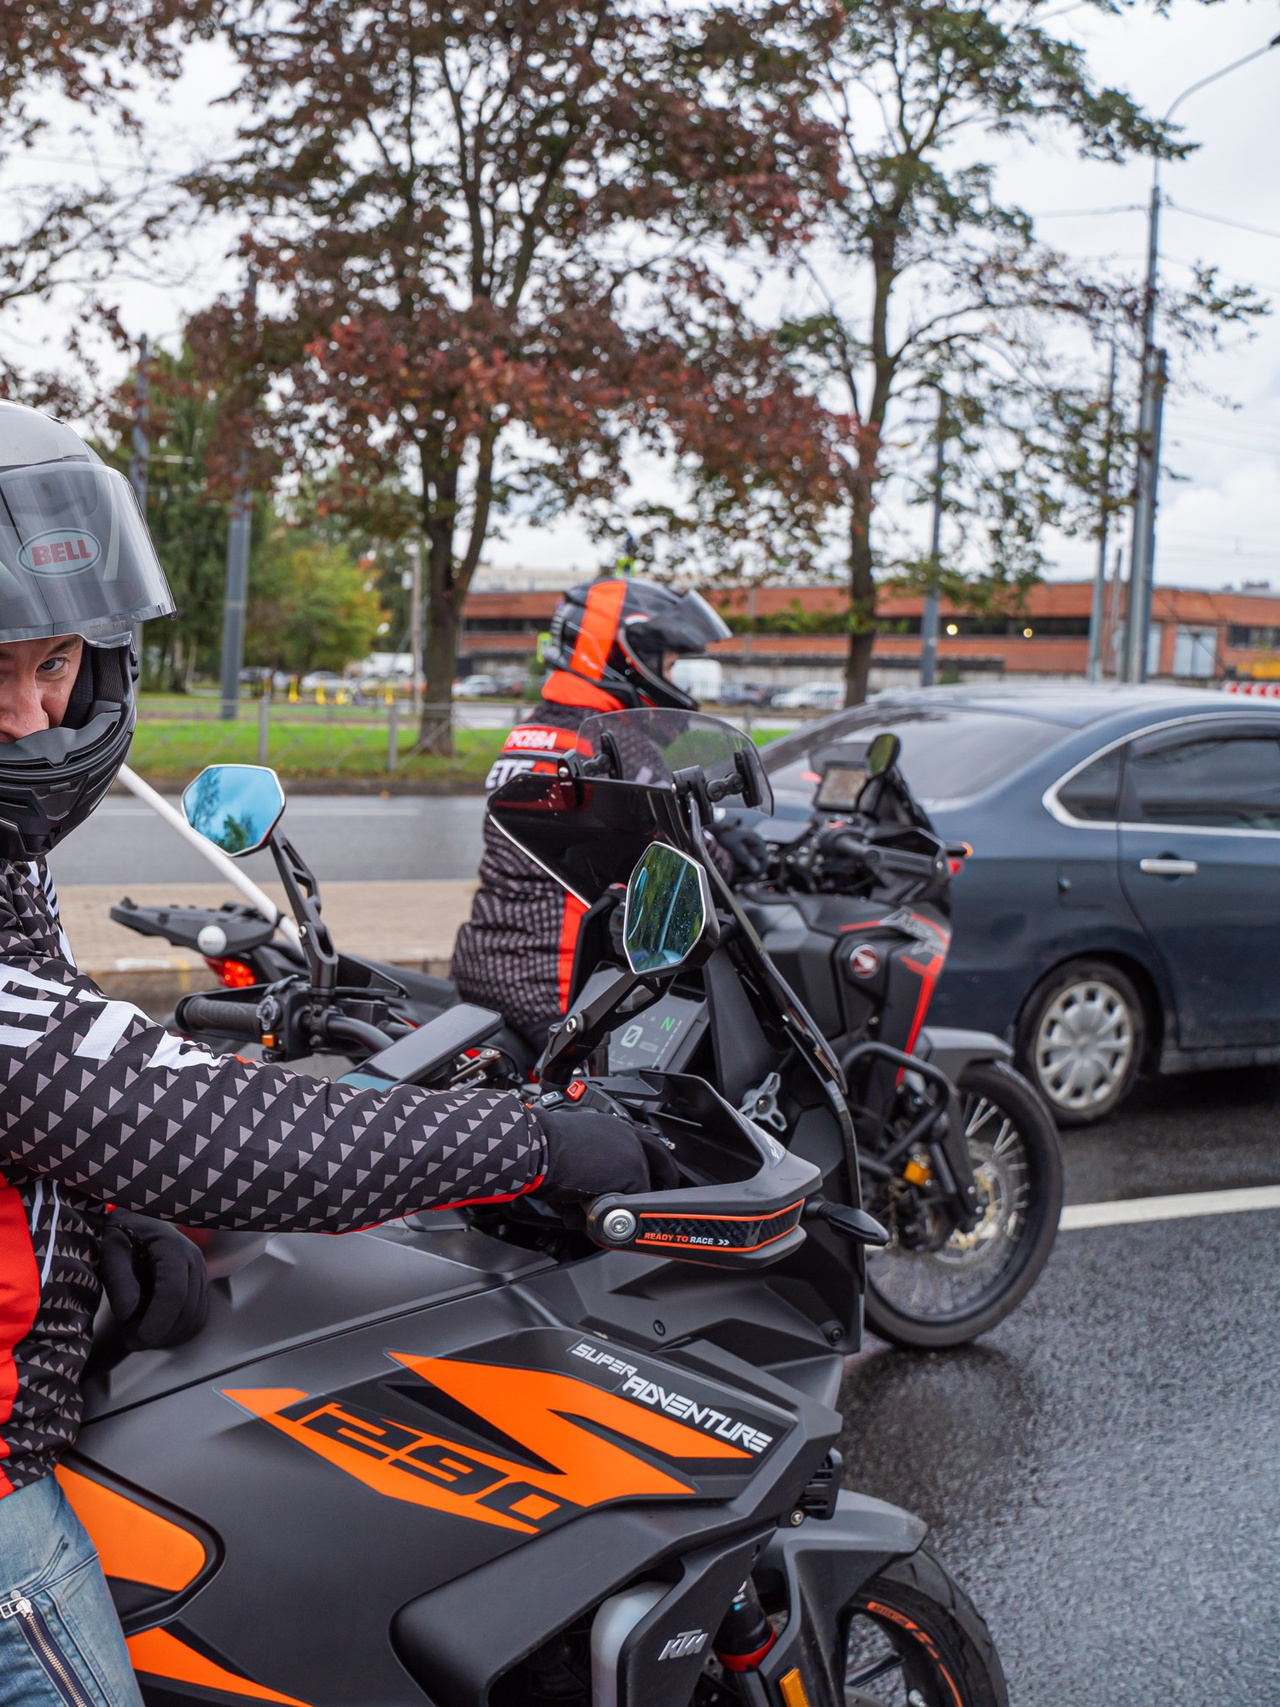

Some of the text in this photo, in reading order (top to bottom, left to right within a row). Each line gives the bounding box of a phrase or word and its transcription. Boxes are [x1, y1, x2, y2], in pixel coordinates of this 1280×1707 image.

[31, 539, 92, 567] BELL
[660, 1016, 676, 1031] N
[644, 1232, 714, 1245] READY TO RACE
[571, 1343, 638, 1378] SUPER
[622, 1375, 773, 1453] ADVENTURE
[657, 1628, 709, 1661] KTM
